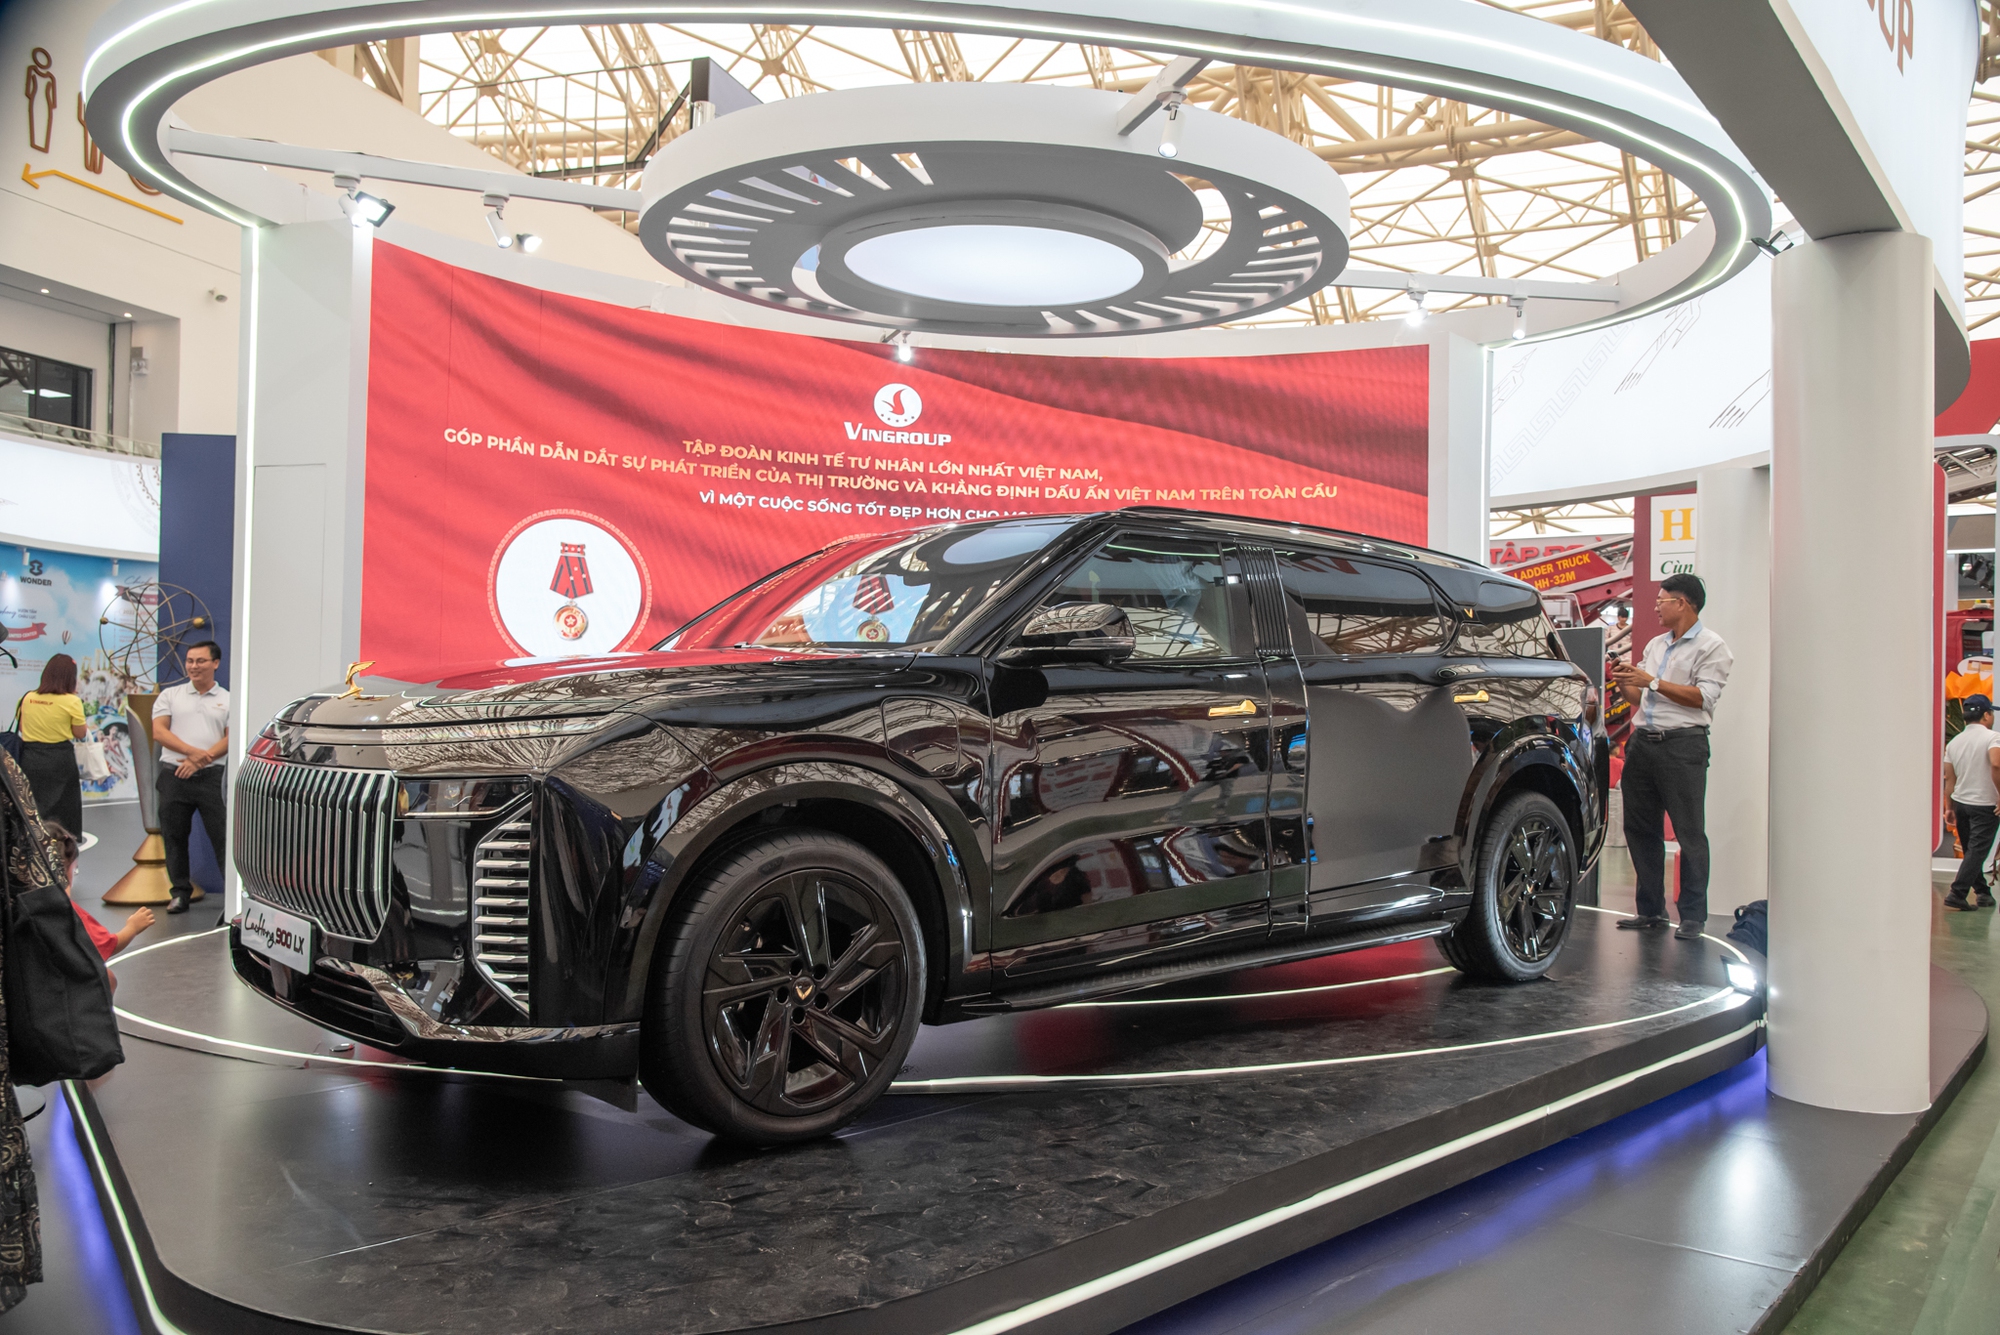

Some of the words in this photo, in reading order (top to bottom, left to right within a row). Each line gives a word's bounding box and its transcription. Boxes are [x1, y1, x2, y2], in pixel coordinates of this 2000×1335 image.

[844, 421, 952, 446] VINGROUP
[444, 427, 483, 446] GÓP
[487, 435, 535, 456] PHẦN
[540, 440, 578, 462] DẪN
[584, 447, 618, 467] DẮT
[622, 455, 647, 472] SỰ
[650, 458, 698, 475] PHÁT
[700, 462, 751, 481] TRIỂN
[755, 466, 792, 484] CỦA
[796, 472, 823, 489] THỊ
[827, 475, 899, 492] TRƯỜNG
[903, 478, 927, 493] VÀ
[932, 478, 992, 497] KHẲNG
[996, 484, 1040, 499] ĐỊNH
[1044, 484, 1081, 499] DẤU
[1084, 485, 1110, 500] ẤN
[1114, 486, 1152, 502] VIỆT
[1155, 489, 1195, 501] NAM
[1199, 486, 1245, 501] TRÊN
[1249, 484, 1297, 500] TOÀN
[1301, 482, 1338, 499] CẦU
[683, 439, 716, 457] TẬP
[720, 445, 772, 462] ĐOÀN
[777, 450, 819, 466] KINH
[823, 452, 845, 468] TẾ
[848, 456, 871, 470] TƯ
[875, 458, 924, 473] NHÂN
[929, 460, 963, 475] LỚN
[968, 462, 1015, 478] NHẤT
[1018, 464, 1056, 482] VIỆT
[1060, 468, 1103, 483] NAM,
[699, 489, 715, 504] VÌ
[719, 492, 756, 508] MỘT
[759, 496, 804, 512] CUỘC
[808, 498, 852, 514] SỐNG
[856, 501, 886, 517] TỐT
[889, 506, 922, 520] ĐẸP
[926, 507, 961, 520] HƠN
[965, 509, 999, 520] CHO
[1659, 508, 1695, 542] H
[1490, 541, 1539, 567] TẬP
[1514, 563, 1554, 581] LADDER
[1556, 553, 1591, 570] TRUCK
[1660, 559, 1695, 575] Cùn
[20, 575, 52, 587] WONDER
[1534, 571, 1576, 590] HH-32M
[276, 927, 293, 949] 900
[294, 934, 305, 955] LX
